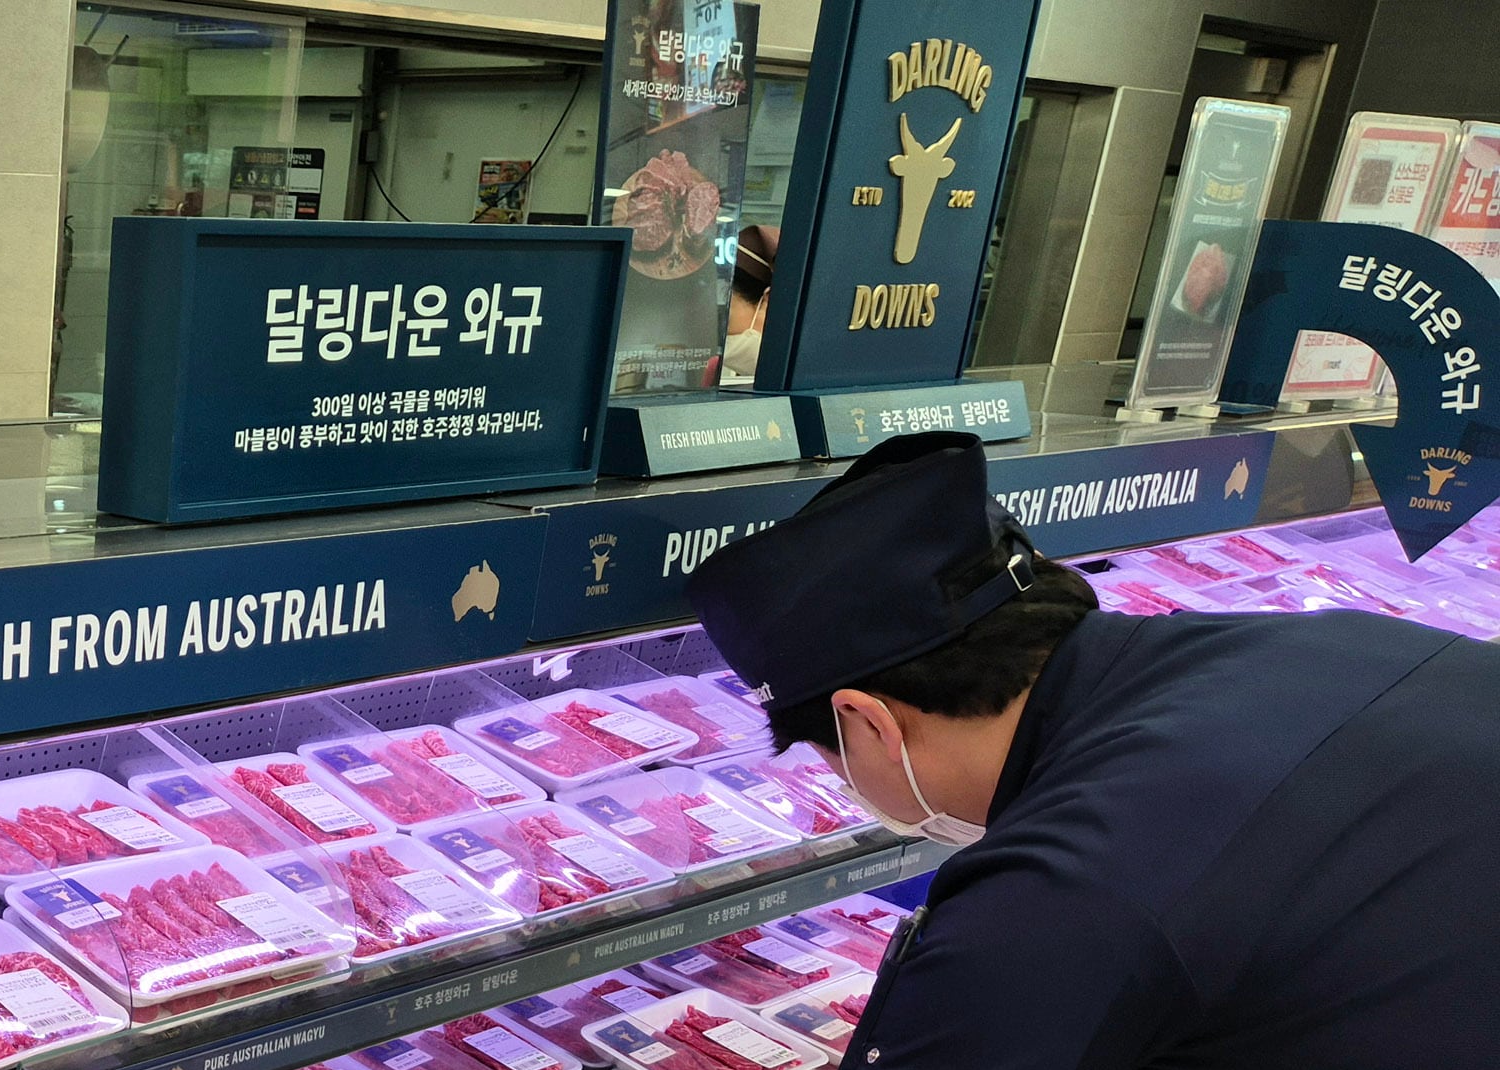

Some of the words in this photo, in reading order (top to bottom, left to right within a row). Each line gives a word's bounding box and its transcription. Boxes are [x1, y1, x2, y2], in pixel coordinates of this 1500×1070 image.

[658, 29, 715, 67] 달링다운
[718, 38, 744, 71] 와규
[887, 38, 994, 113] DARLING
[852, 186, 884, 206] ESTD
[947, 189, 977, 208] 2002
[265, 283, 450, 364] 달링다운
[459, 282, 544, 356] 와규
[848, 283, 940, 331] DOWNS
[1339, 253, 1464, 346] 달링다운
[1440, 346, 1482, 415] 와규
[311, 393, 355, 418] 300일
[357, 392, 387, 415] 이상
[389, 390, 430, 414] 곡물을
[433, 386, 486, 411] 먹여키워
[879, 407, 905, 434] 호주
[907, 401, 954, 432] 청정와규
[961, 397, 1012, 427] 달링다운
[234, 425, 296, 454] 마블링이
[298, 421, 357, 449] 풍부하고
[360, 419, 388, 444] 맛이
[391, 417, 419, 442] 진한
[421, 414, 473, 440] 호주청정
[476, 408, 544, 436] 와규입니다.
[660, 432, 689, 451] FRESH
[690, 429, 715, 448] FROM
[716, 425, 761, 445] AUSTRALIA
[1420, 447, 1472, 466] DARLING
[1046, 480, 1104, 523] FROM
[1102, 468, 1198, 515] AUSTRALIA
[1409, 496, 1453, 513] DOWNS
[49, 604, 168, 674] FROM
[179, 580, 386, 657] AUSTRALIA
[594, 943, 614, 959] PURE
[614, 929, 659, 954] AUSTRALIAN
[659, 922, 685, 941] WAGYU
[413, 994, 433, 1011] 호주
[482, 969, 518, 992] 달링다운
[231, 1033, 292, 1065] AUSTRALIAN
[292, 1024, 326, 1047] WAGYU
